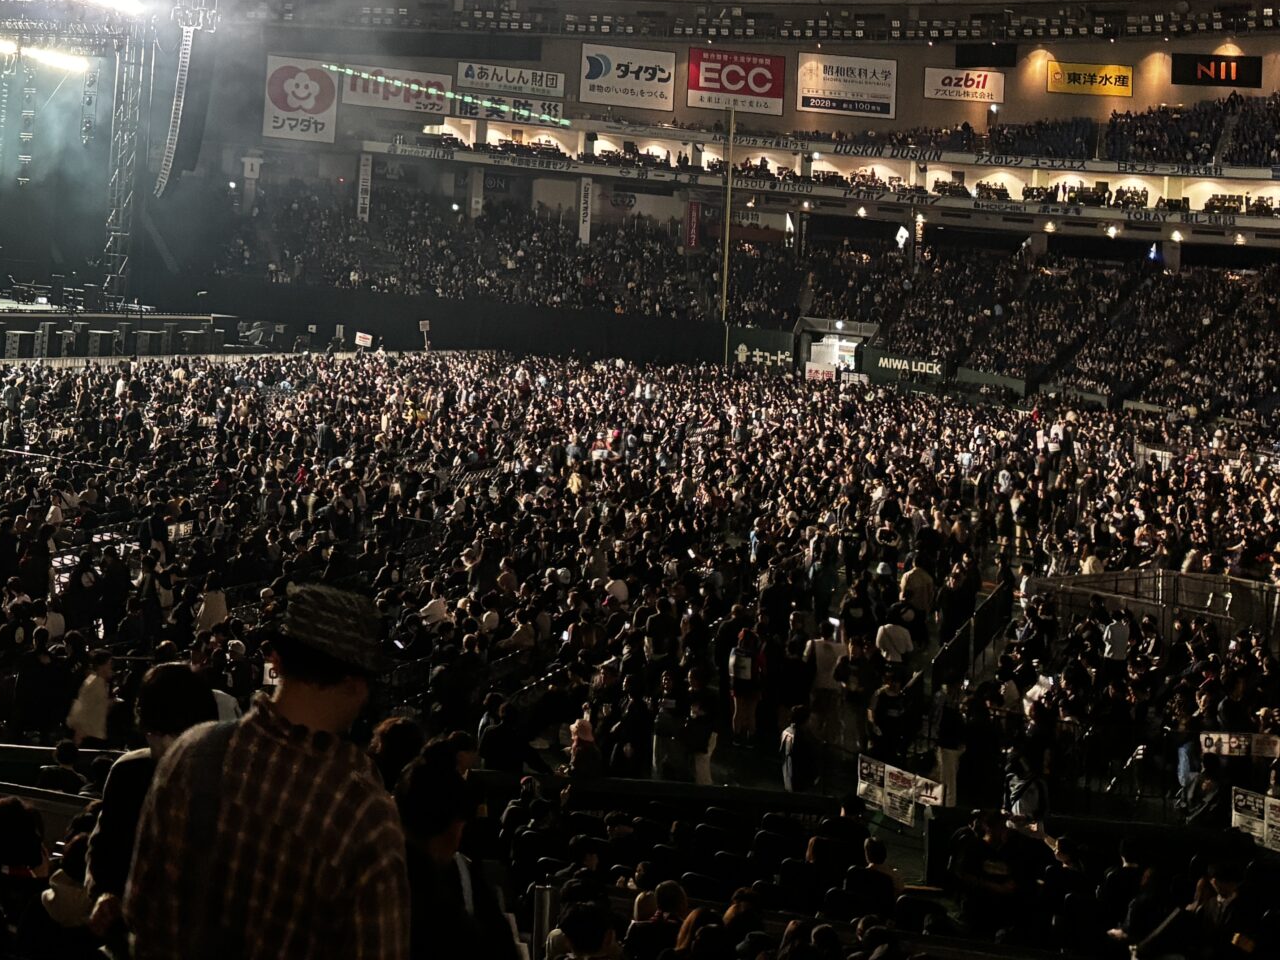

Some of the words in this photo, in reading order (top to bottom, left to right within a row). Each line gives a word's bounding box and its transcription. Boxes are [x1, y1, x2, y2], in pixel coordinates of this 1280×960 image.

[477, 66, 558, 89] あんしん財団
[615, 62, 671, 83] ダイダン
[699, 62, 773, 94] ECC
[823, 65, 892, 81] 昭和医科大学
[941, 73, 988, 90] azbil
[1067, 71, 1129, 87] 東洋水産
[272, 115, 325, 134] シマダヤ
[833, 142, 884, 157] DUSKIN
[891, 147, 942, 161] DUSKIN
[752, 348, 793, 366] キューピー
[878, 357, 910, 370] MIWA
[912, 360, 942, 374] LOCK
